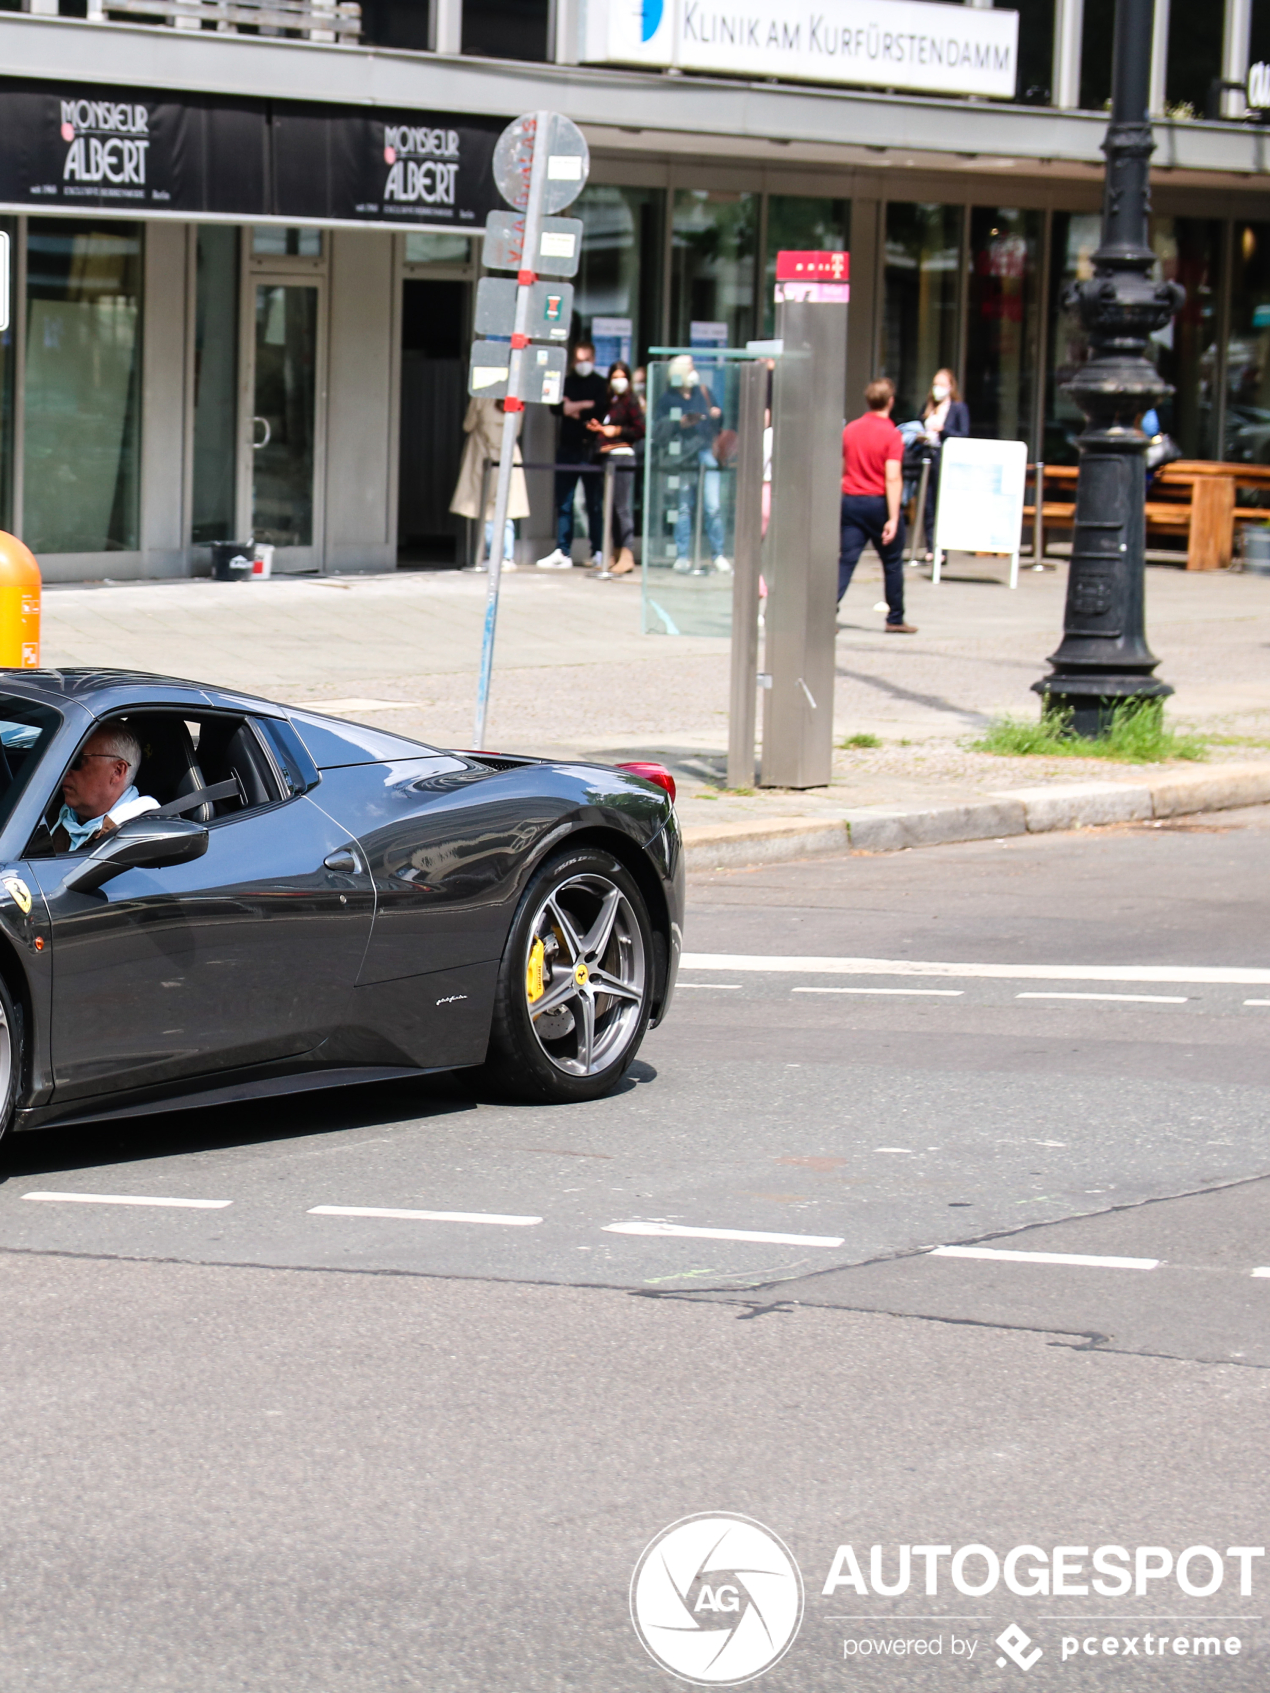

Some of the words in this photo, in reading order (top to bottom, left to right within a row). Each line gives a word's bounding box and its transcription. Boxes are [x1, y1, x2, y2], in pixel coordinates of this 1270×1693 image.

[684, 2, 760, 48] KLINIK
[766, 20, 801, 50] AM
[809, 14, 1010, 71] KURFÜRSTENDAMM
[60, 99, 149, 133] MONSIEUR
[63, 137, 150, 184] ALBERT
[384, 125, 460, 158] MONSIEUR
[384, 160, 460, 205] ALBERT
